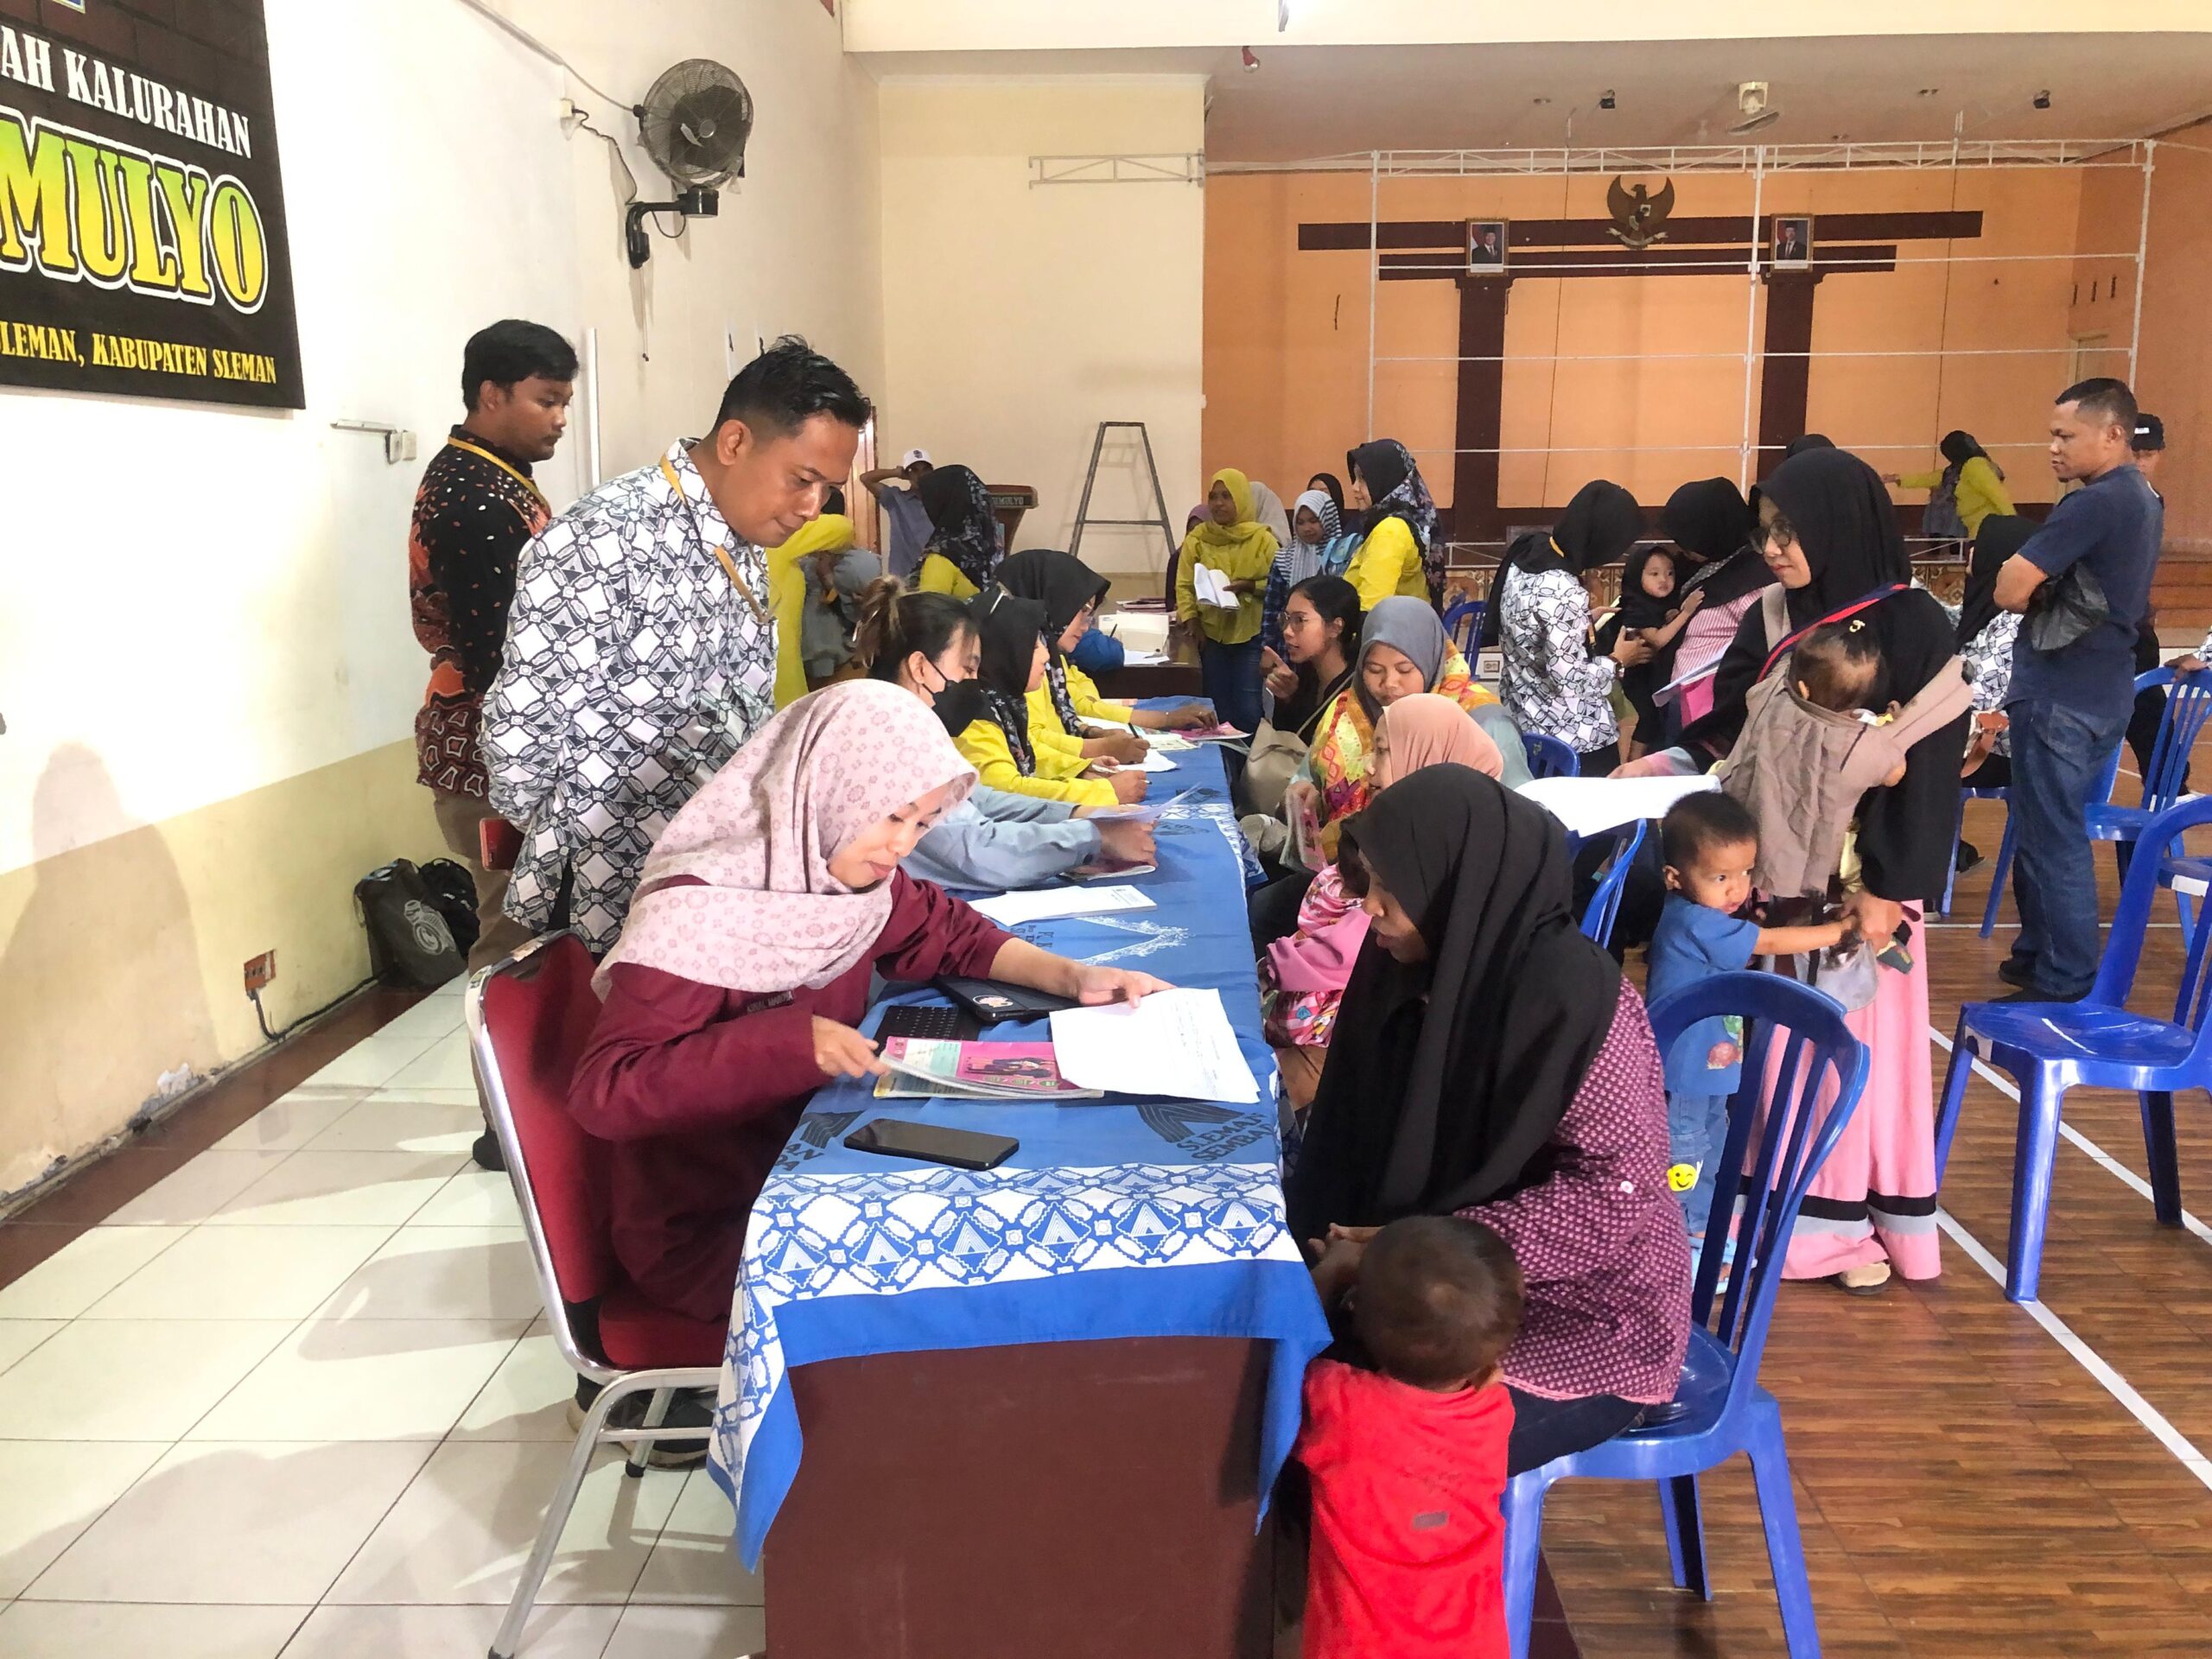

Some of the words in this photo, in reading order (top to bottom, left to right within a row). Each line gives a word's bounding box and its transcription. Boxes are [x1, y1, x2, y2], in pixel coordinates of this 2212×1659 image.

[1, 24, 56, 93] AH
[62, 48, 251, 159] KALURAHAN
[0, 106, 269, 315] MULYO
[0, 320, 85, 368] LEMAN,
[92, 333, 207, 377] KABUPATEN
[213, 349, 276, 385] SLEMAN
